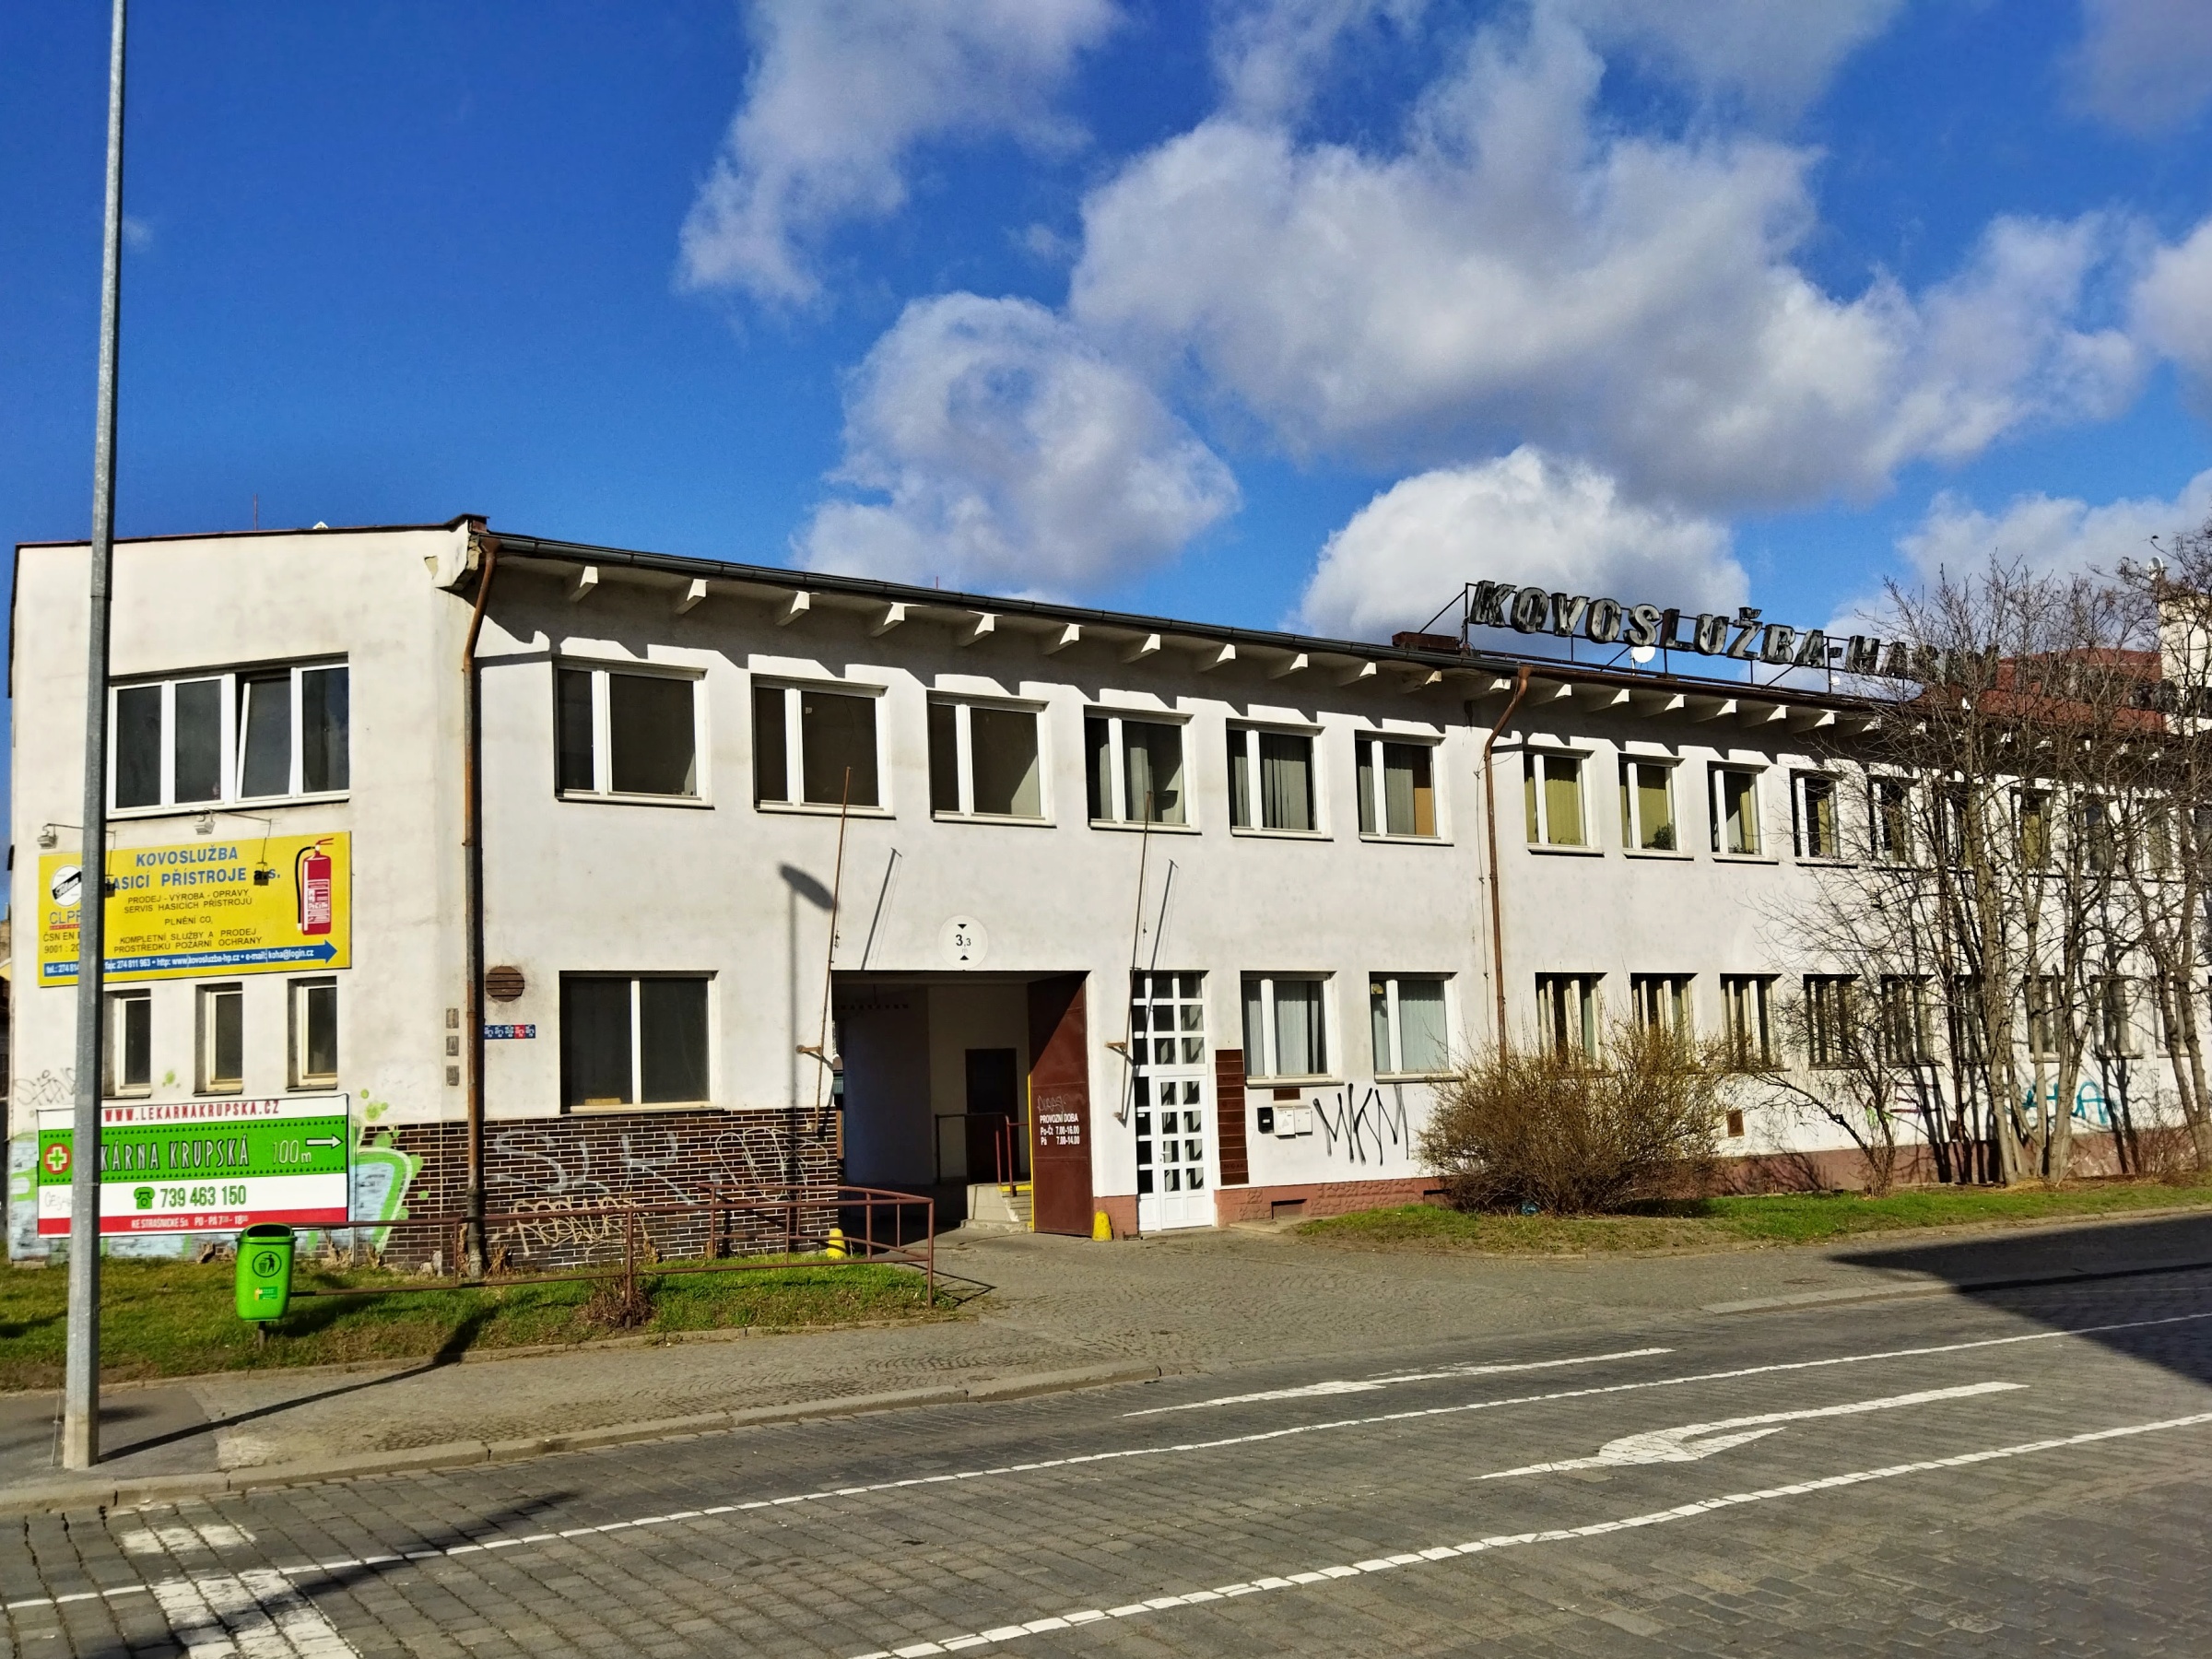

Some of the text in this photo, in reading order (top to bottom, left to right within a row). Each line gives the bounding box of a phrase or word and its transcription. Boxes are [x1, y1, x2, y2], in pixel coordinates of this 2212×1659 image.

[135, 844, 238, 866] KOVOSLUŽBA
[161, 867, 246, 886] PŘÍSTROJE
[128, 895, 161, 904] PRODEJ
[169, 891, 205, 901] VÝROBA
[213, 888, 249, 899] OPRAVY
[124, 905, 153, 913] SERVIS
[63, 931, 75, 940] EN
[220, 928, 256, 937] PRODEJ
[218, 936, 262, 947] OCHRANY
[44, 945, 63, 953] 9001
[105, 1100, 279, 1122] WWW.LEKARNAKRUPSKA.CZ
[1040, 1112, 1078, 1124] PROVOZNÍ DOBA
[169, 1134, 250, 1169] KRUPSKÁ
[273, 1139, 299, 1164] 100
[159, 1184, 246, 1207] 739 463 150
